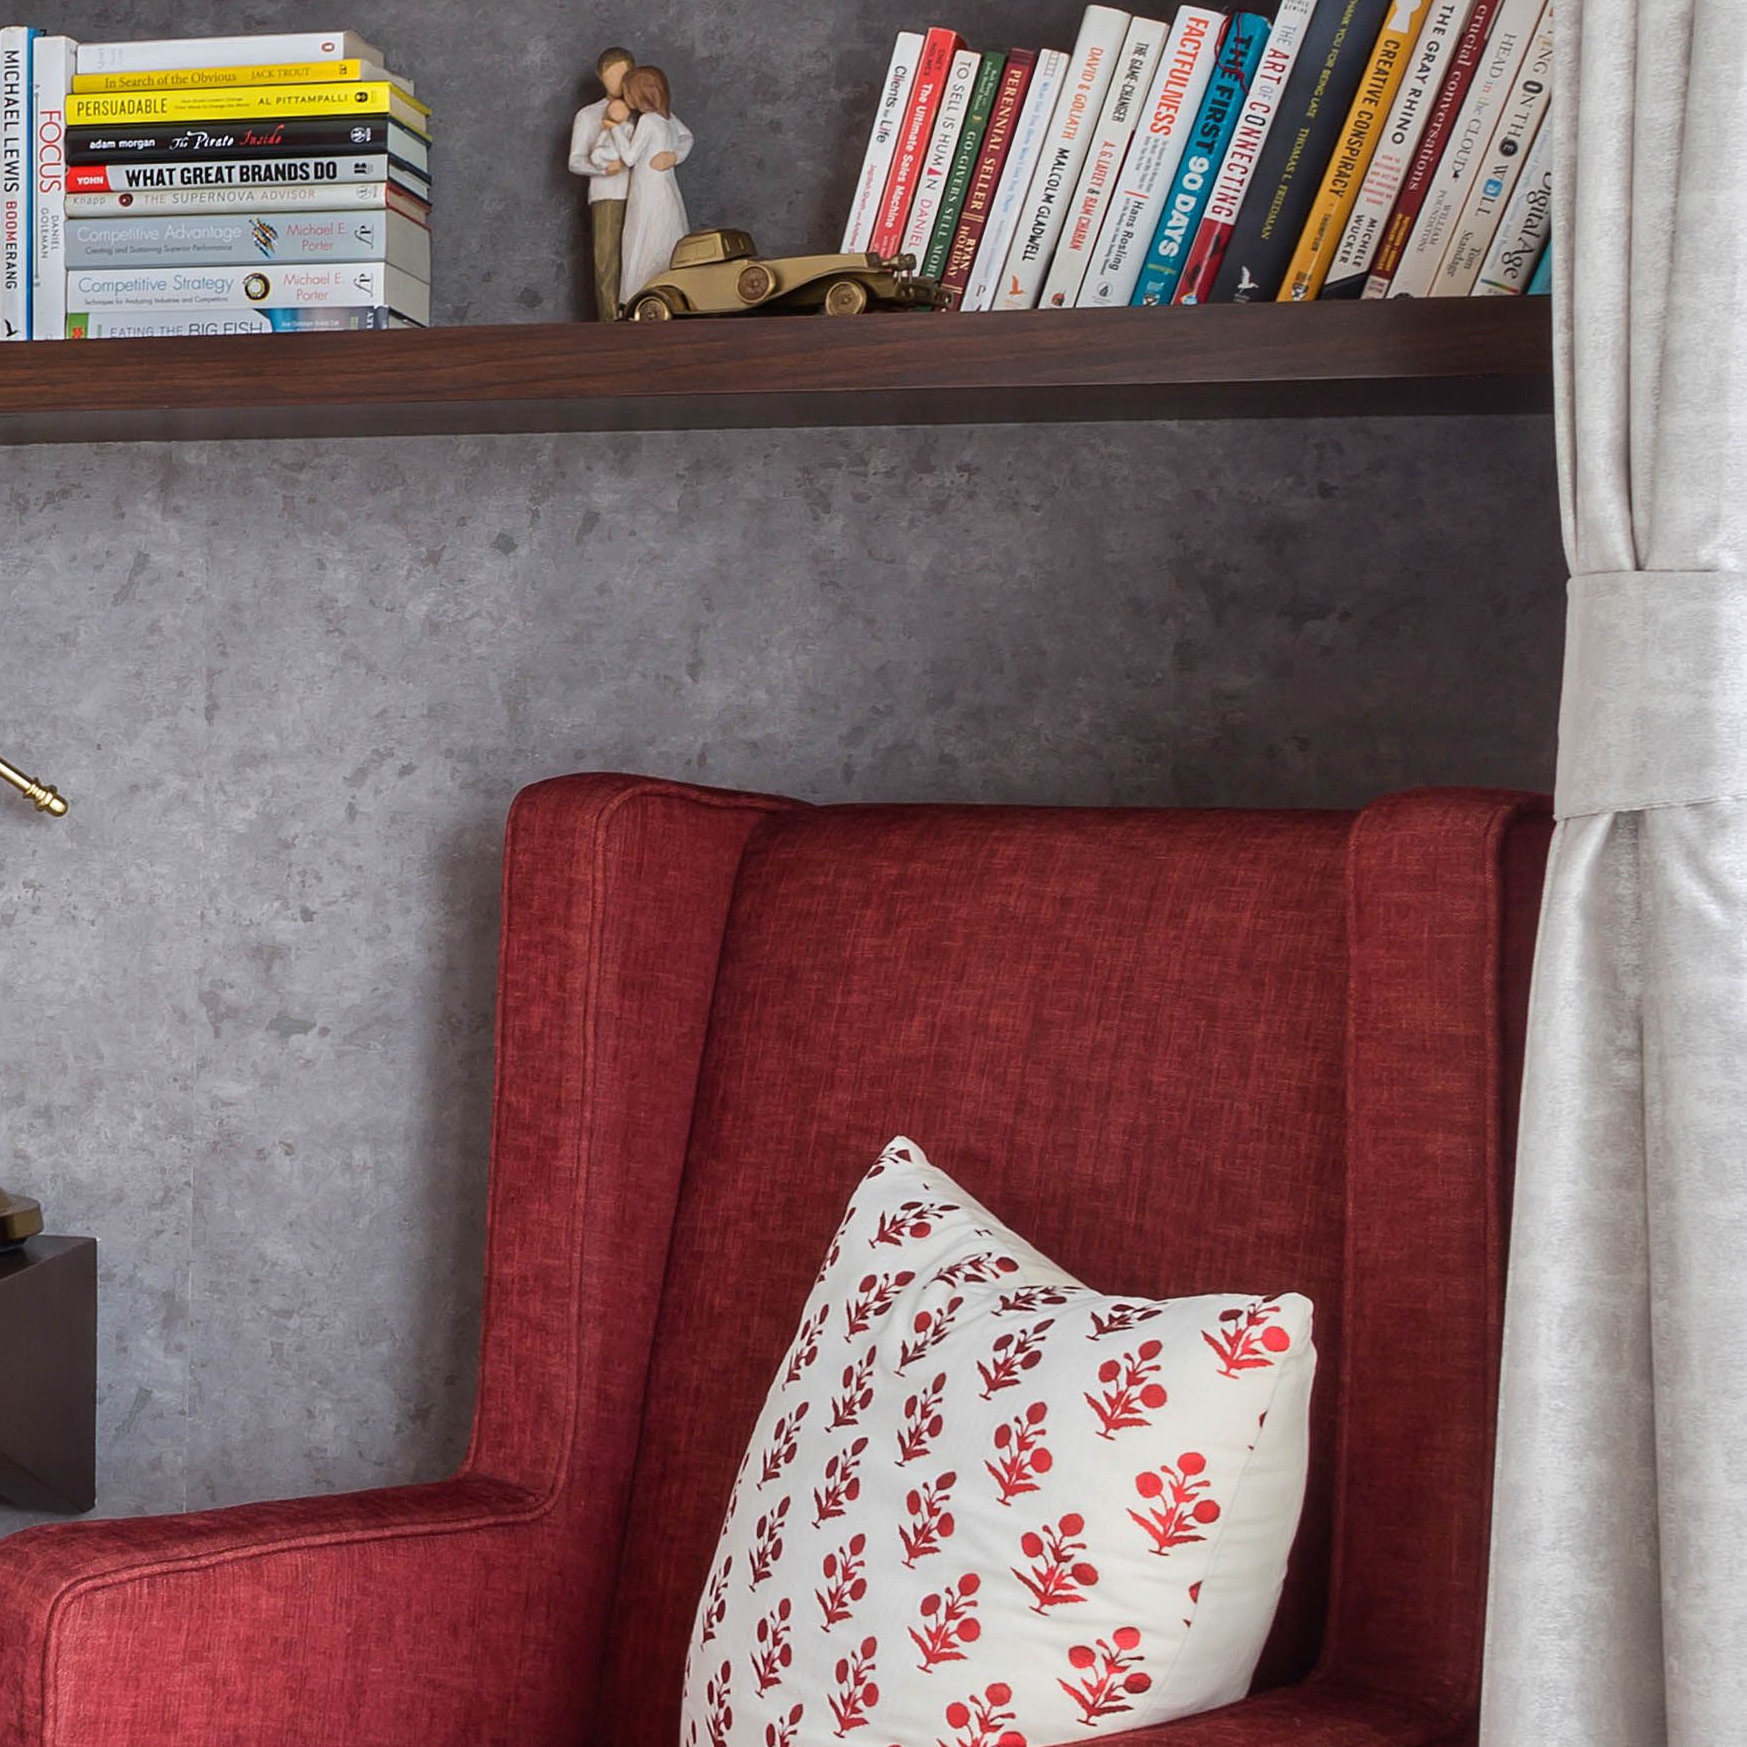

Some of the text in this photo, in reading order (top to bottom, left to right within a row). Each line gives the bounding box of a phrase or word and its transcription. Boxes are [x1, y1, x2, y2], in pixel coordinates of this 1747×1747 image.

[77, 99, 167, 116] PERSUADABLE
[1149, 17, 1209, 137] FACTFULNESS
[1362, 40, 1400, 106] CREATIVE
[4, 50, 20, 289] MICHAEL LEWIS BOOMERANG
[40, 110, 61, 194] FOCUS
[126, 162, 337, 187] WHAT GREAT BRANDS DO
[1158, 85, 1235, 257] FIRST 90 DAYS
[1211, 101, 1271, 218] CONNECTING
[1328, 111, 1374, 197] CONSPIRACY
[1023, 147, 1070, 261] MALCOLM GLADWELL
